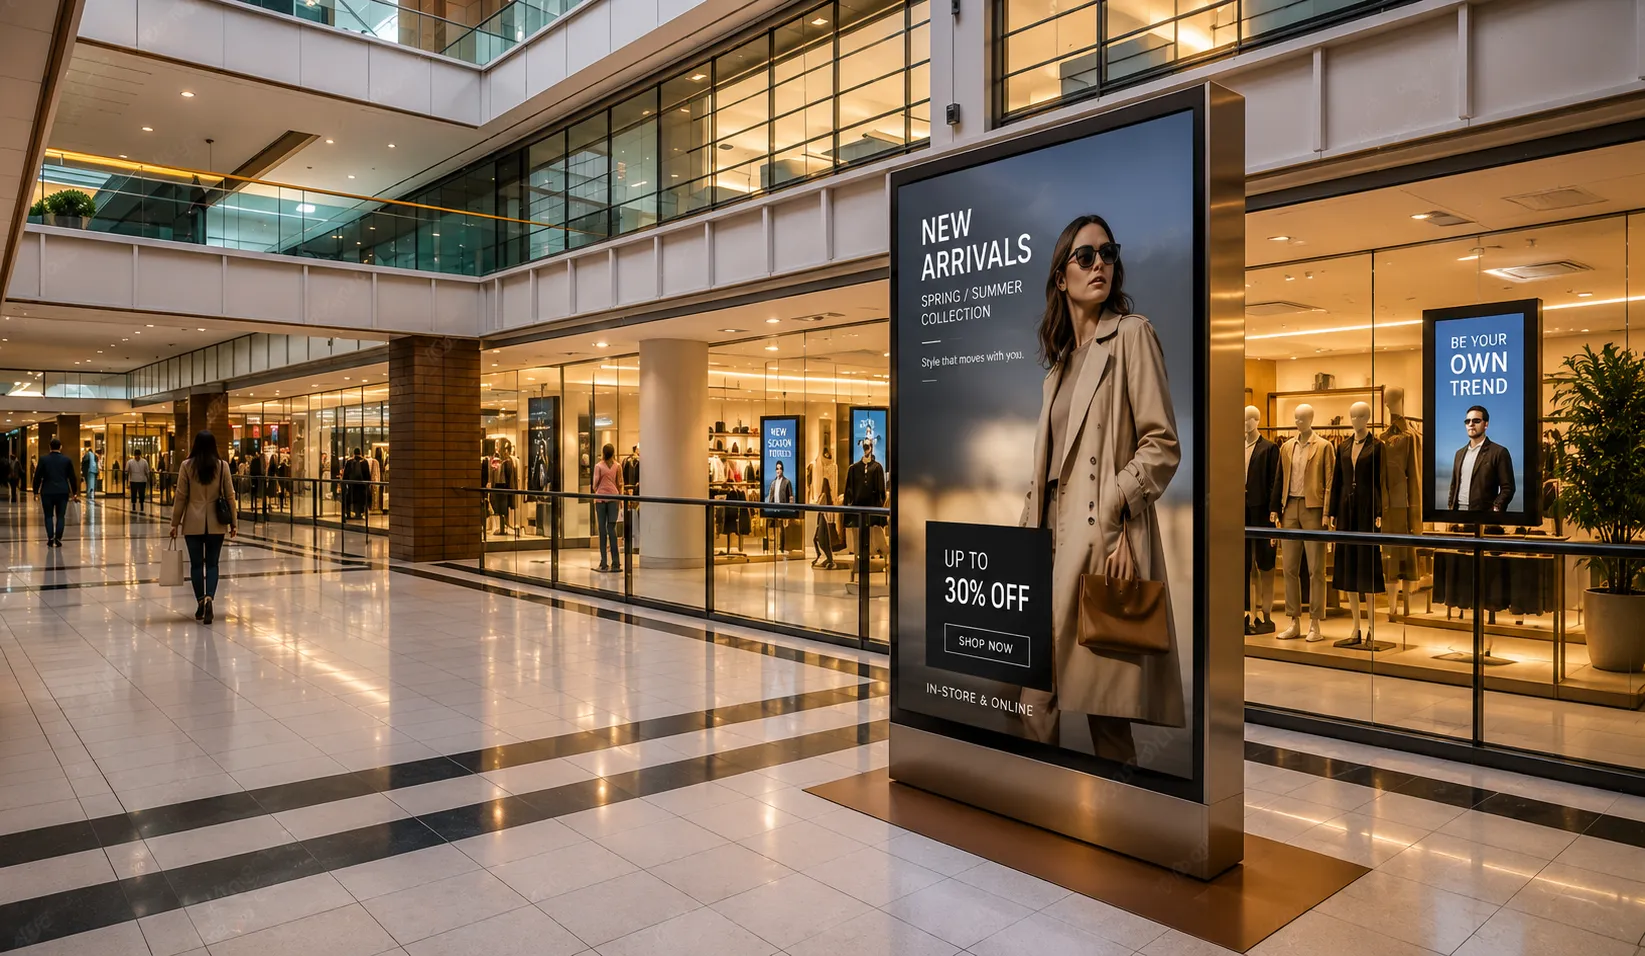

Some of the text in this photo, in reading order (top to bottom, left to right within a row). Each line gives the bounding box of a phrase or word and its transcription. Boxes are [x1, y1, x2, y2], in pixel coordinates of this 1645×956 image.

[922, 208, 972, 245] NEW
[921, 233, 1032, 281] ARRIVALS
[921, 280, 1023, 307] SPRING / SUMMER
[921, 304, 991, 325] COLLECTION
[1451, 333, 1507, 349] BE YOUR
[921, 356, 940, 369] Style
[942, 355, 958, 365] that
[959, 355, 985, 364] moves
[987, 350, 1004, 361] with
[1450, 351, 1508, 374] OWN
[1450, 378, 1508, 396] TREND
[770, 428, 787, 436] NEW
[944, 549, 988, 571] UP TO
[944, 576, 1030, 612] 30% OFF
[958, 635, 1013, 654] SHOP NOW
[926, 682, 1034, 717] IN-STORE & ONLINE
